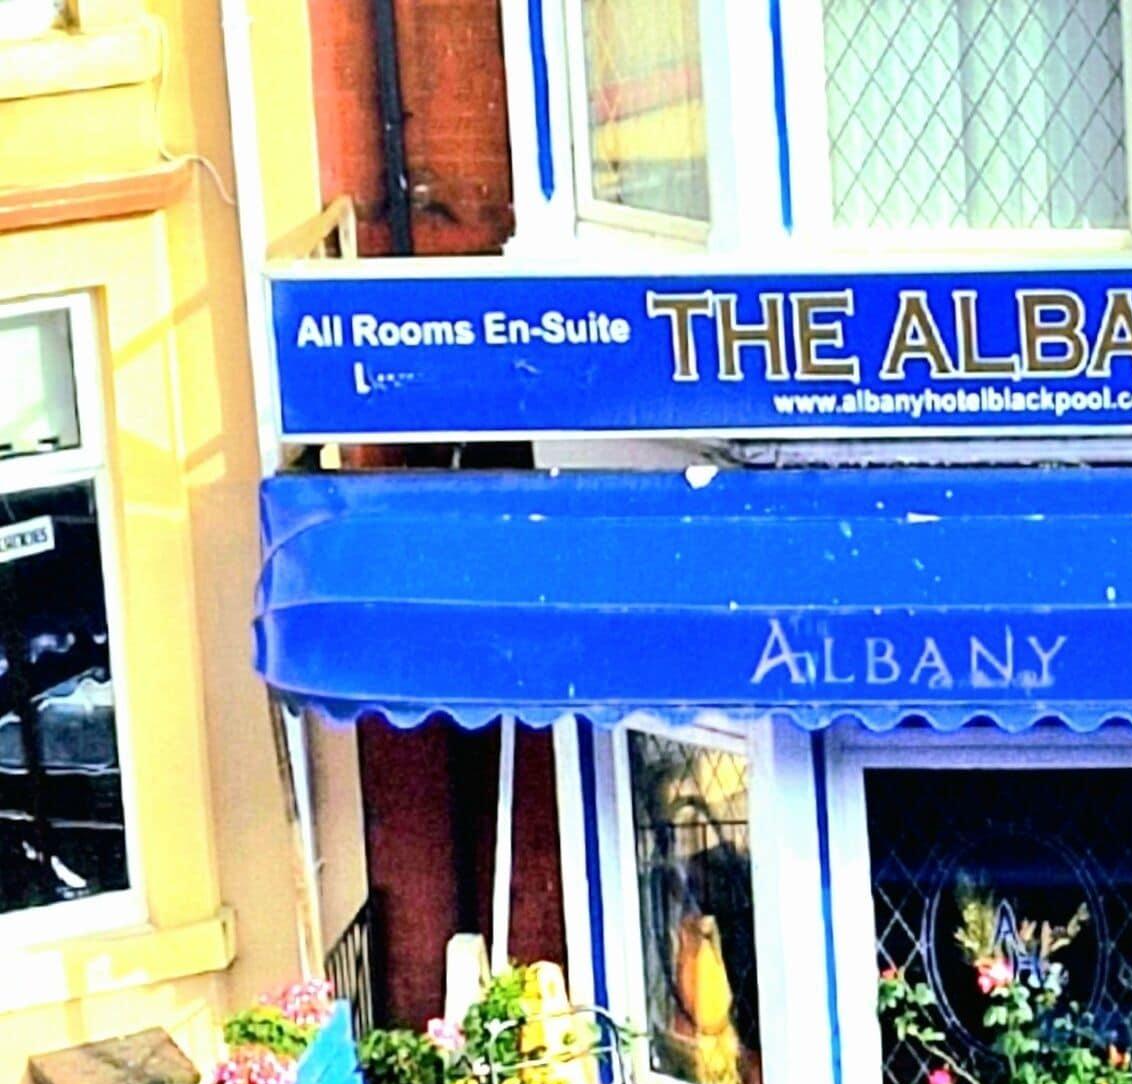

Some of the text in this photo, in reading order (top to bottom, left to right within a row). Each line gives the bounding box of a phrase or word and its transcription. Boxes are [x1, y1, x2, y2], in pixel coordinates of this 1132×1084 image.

[297, 311, 631, 348] All Rooms En-Suite
[647, 289, 857, 382] THE
